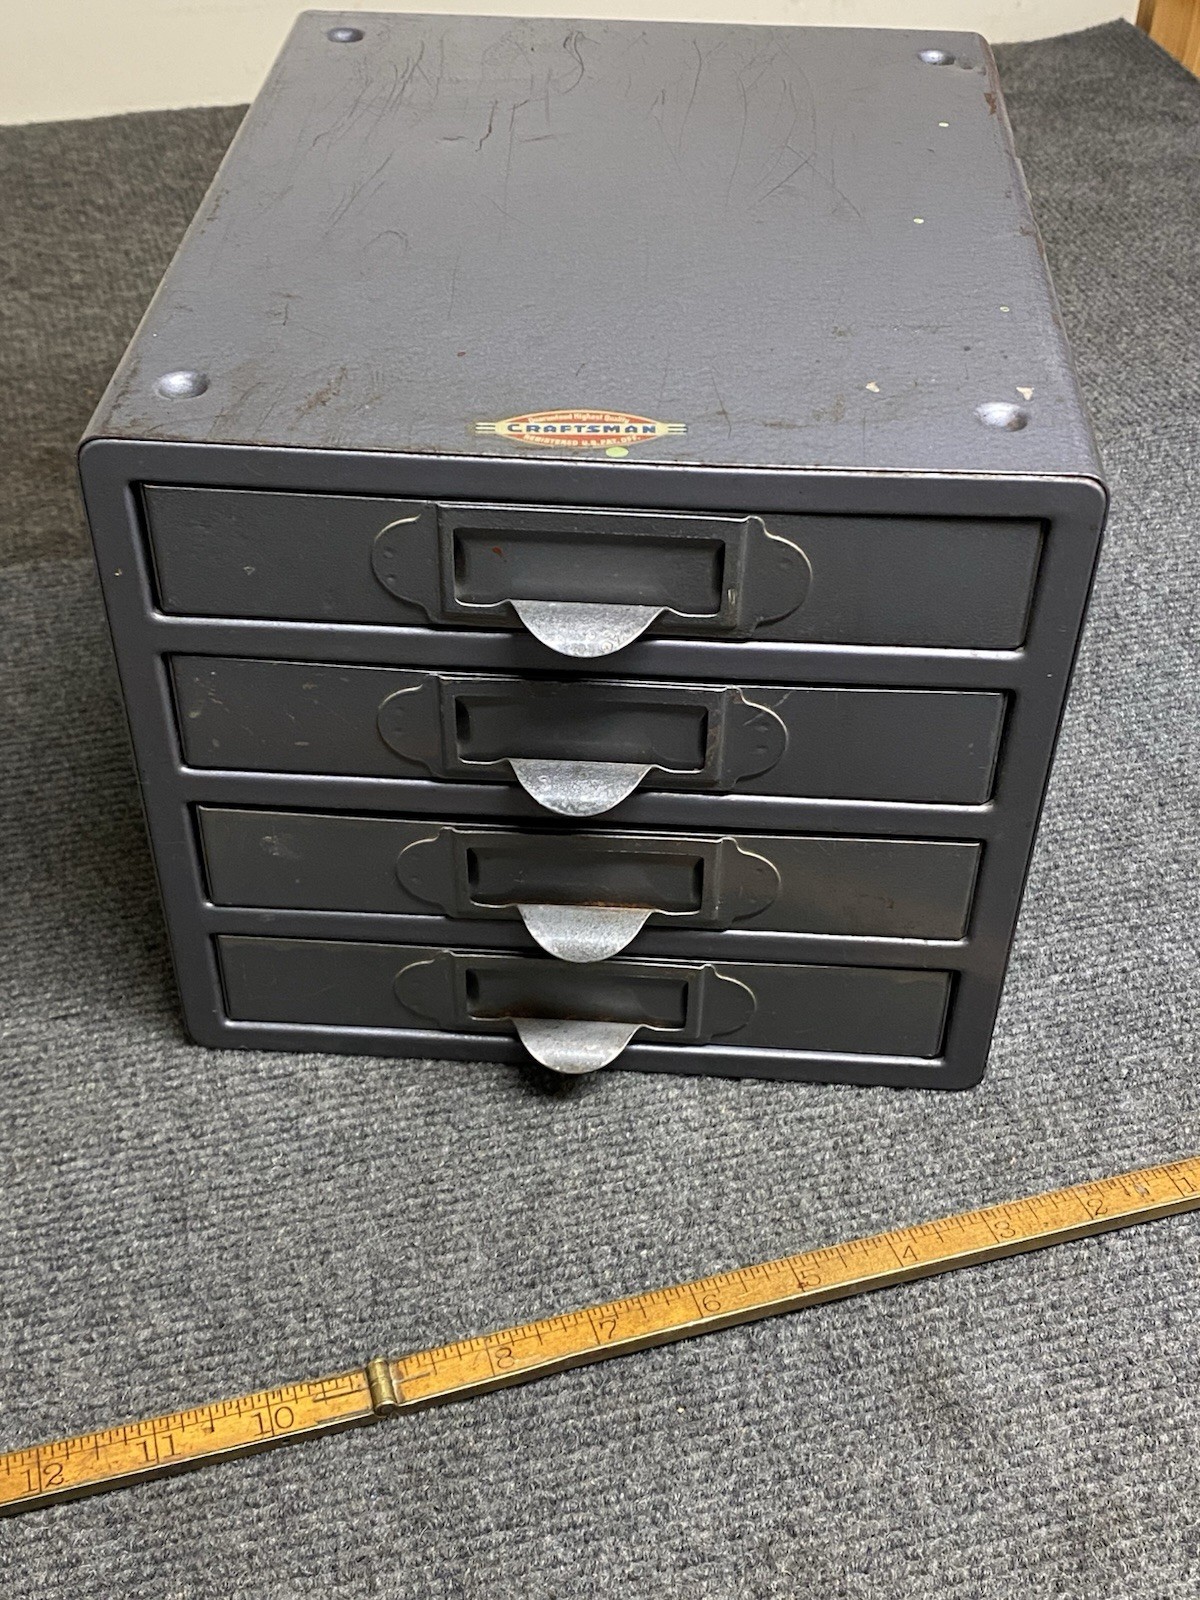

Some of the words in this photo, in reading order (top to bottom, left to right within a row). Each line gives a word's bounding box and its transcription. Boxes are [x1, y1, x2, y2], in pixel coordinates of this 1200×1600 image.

[507, 424, 656, 433] CRAFTSMAN
[21, 1461, 65, 1494] 12
[136, 1434, 181, 1462] 11
[252, 1406, 294, 1436] 10
[495, 1347, 515, 1369] 8
[599, 1318, 619, 1339] 7
[702, 1293, 721, 1312] 6
[800, 1268, 821, 1287] 5
[902, 1245, 919, 1262] 4
[1000, 1221, 1016, 1239] 3
[1087, 1199, 1108, 1216] 2
